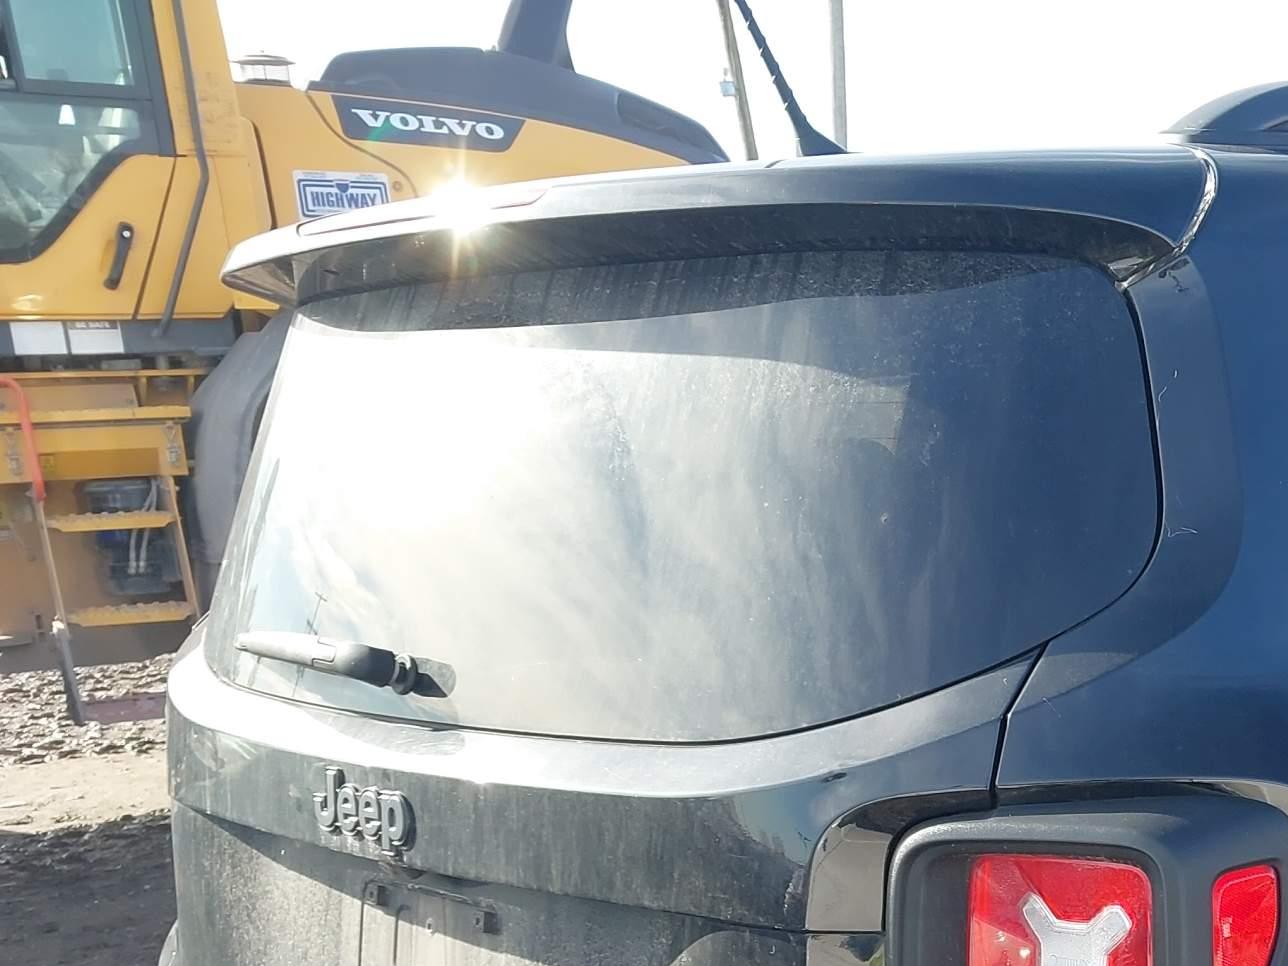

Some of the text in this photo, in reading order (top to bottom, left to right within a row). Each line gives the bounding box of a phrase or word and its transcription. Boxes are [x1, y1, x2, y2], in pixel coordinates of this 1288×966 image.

[351, 109, 504, 139] VOLVO
[310, 191, 377, 208] HIGHWAY
[312, 766, 416, 856] Jeep
